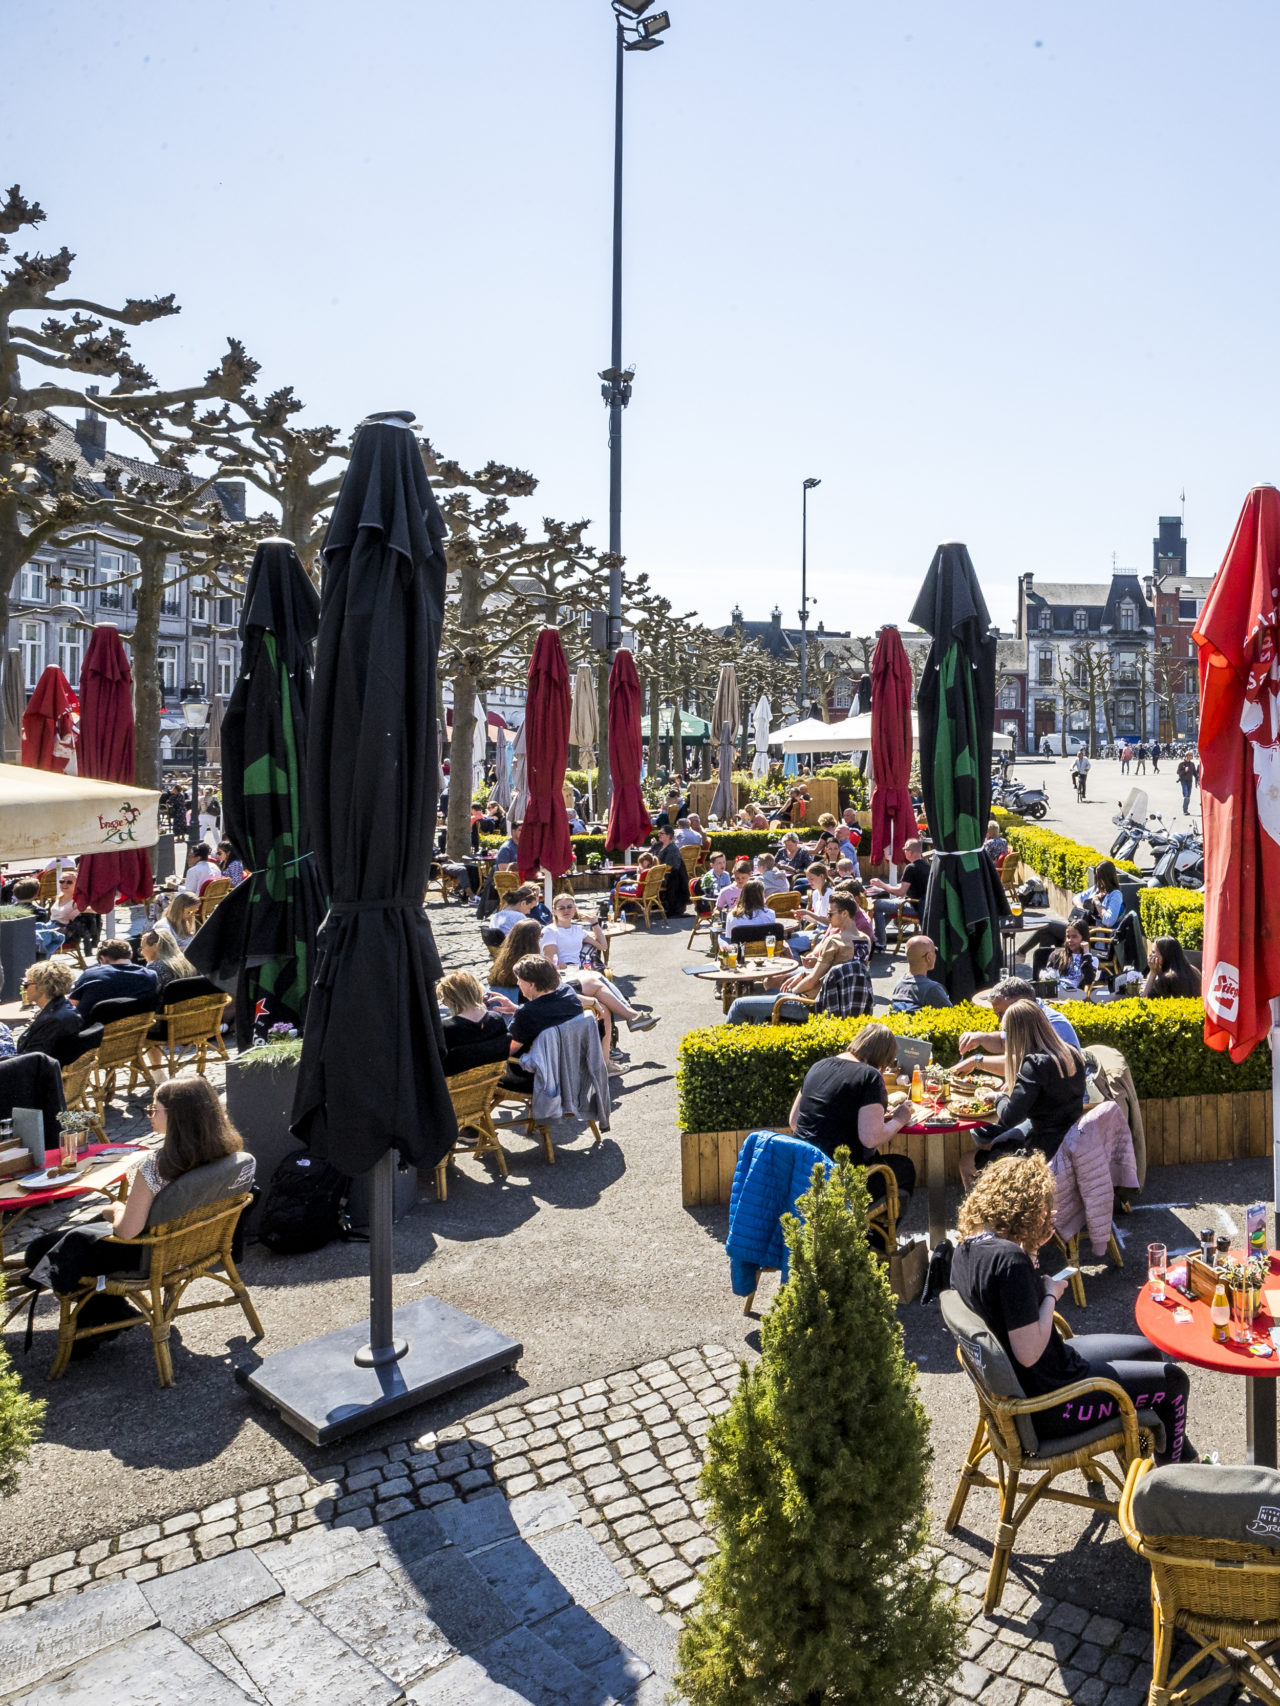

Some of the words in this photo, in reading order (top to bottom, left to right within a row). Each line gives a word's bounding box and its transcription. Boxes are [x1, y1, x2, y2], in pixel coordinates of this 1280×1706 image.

[101, 828, 138, 844] Zot
[1213, 974, 1240, 999] Stieg
[1077, 1391, 1167, 1422] UNER
